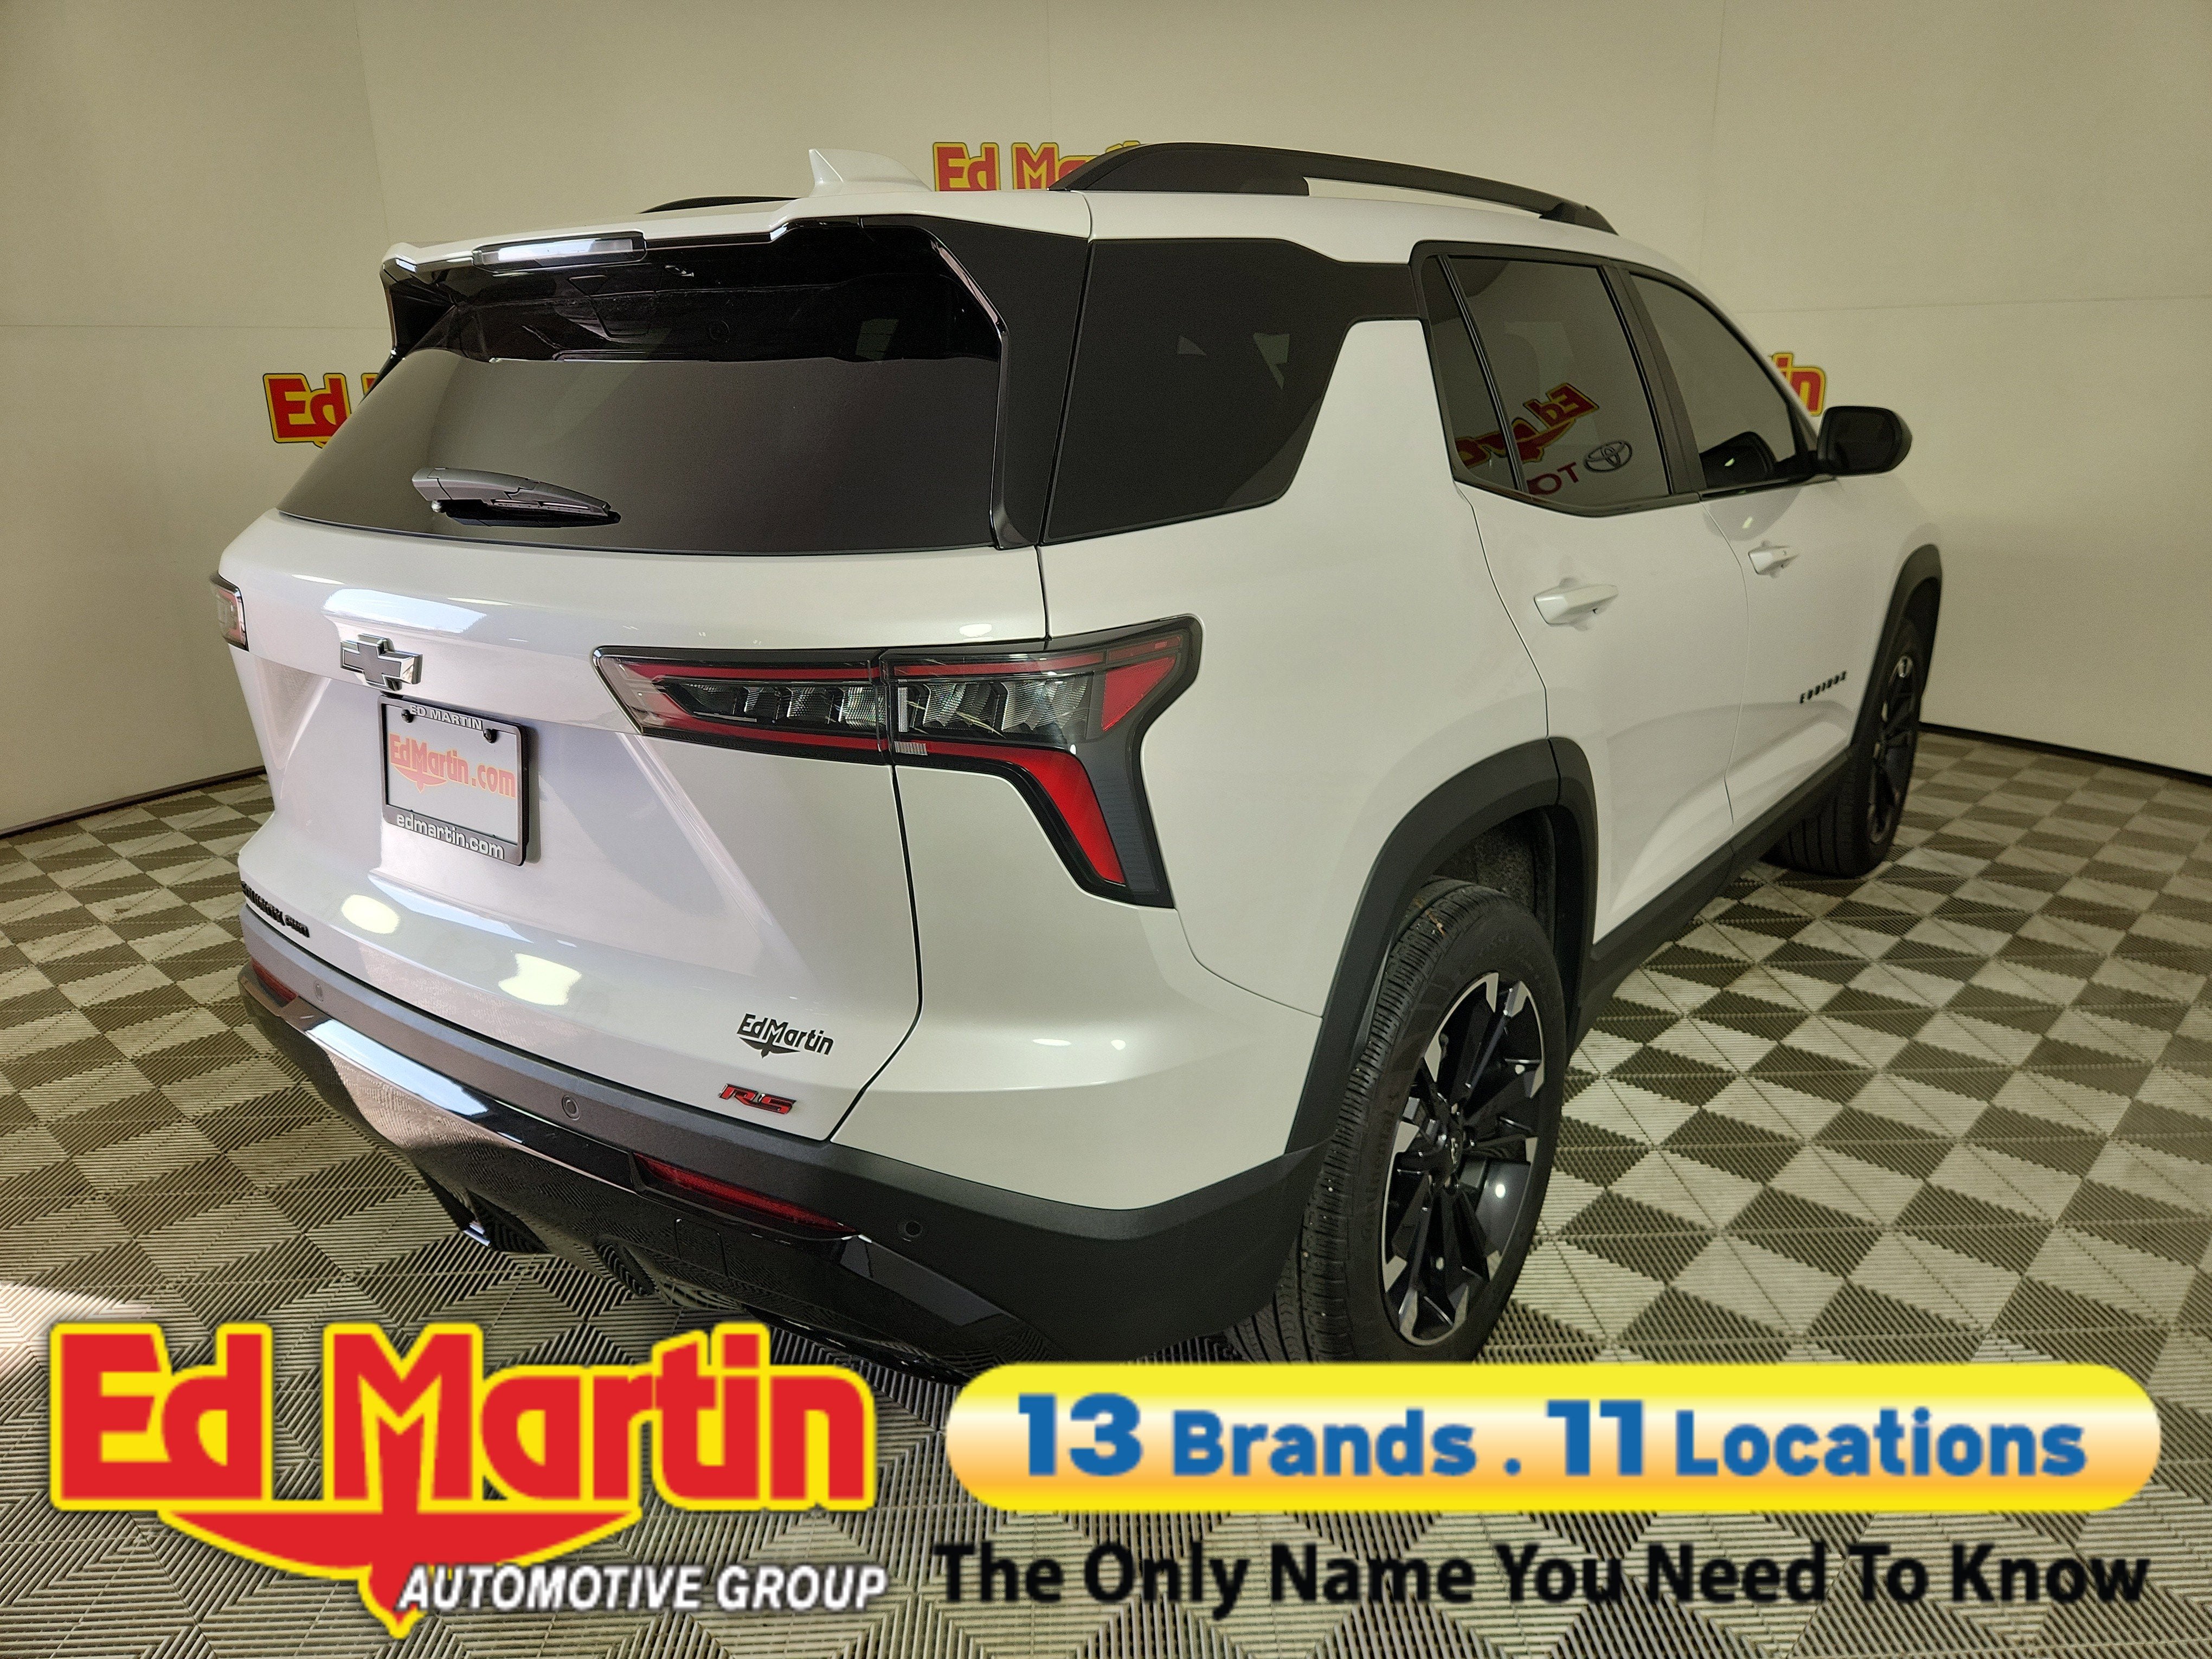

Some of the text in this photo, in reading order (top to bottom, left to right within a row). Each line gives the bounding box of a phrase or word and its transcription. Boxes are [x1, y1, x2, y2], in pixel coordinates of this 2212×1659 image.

[933, 142, 1000, 191] Ed
[263, 373, 352, 443] Ed
[409, 705, 484, 731] ED MARTIN
[396, 813, 504, 860] edmartin.com
[718, 1083, 796, 1115] RS
